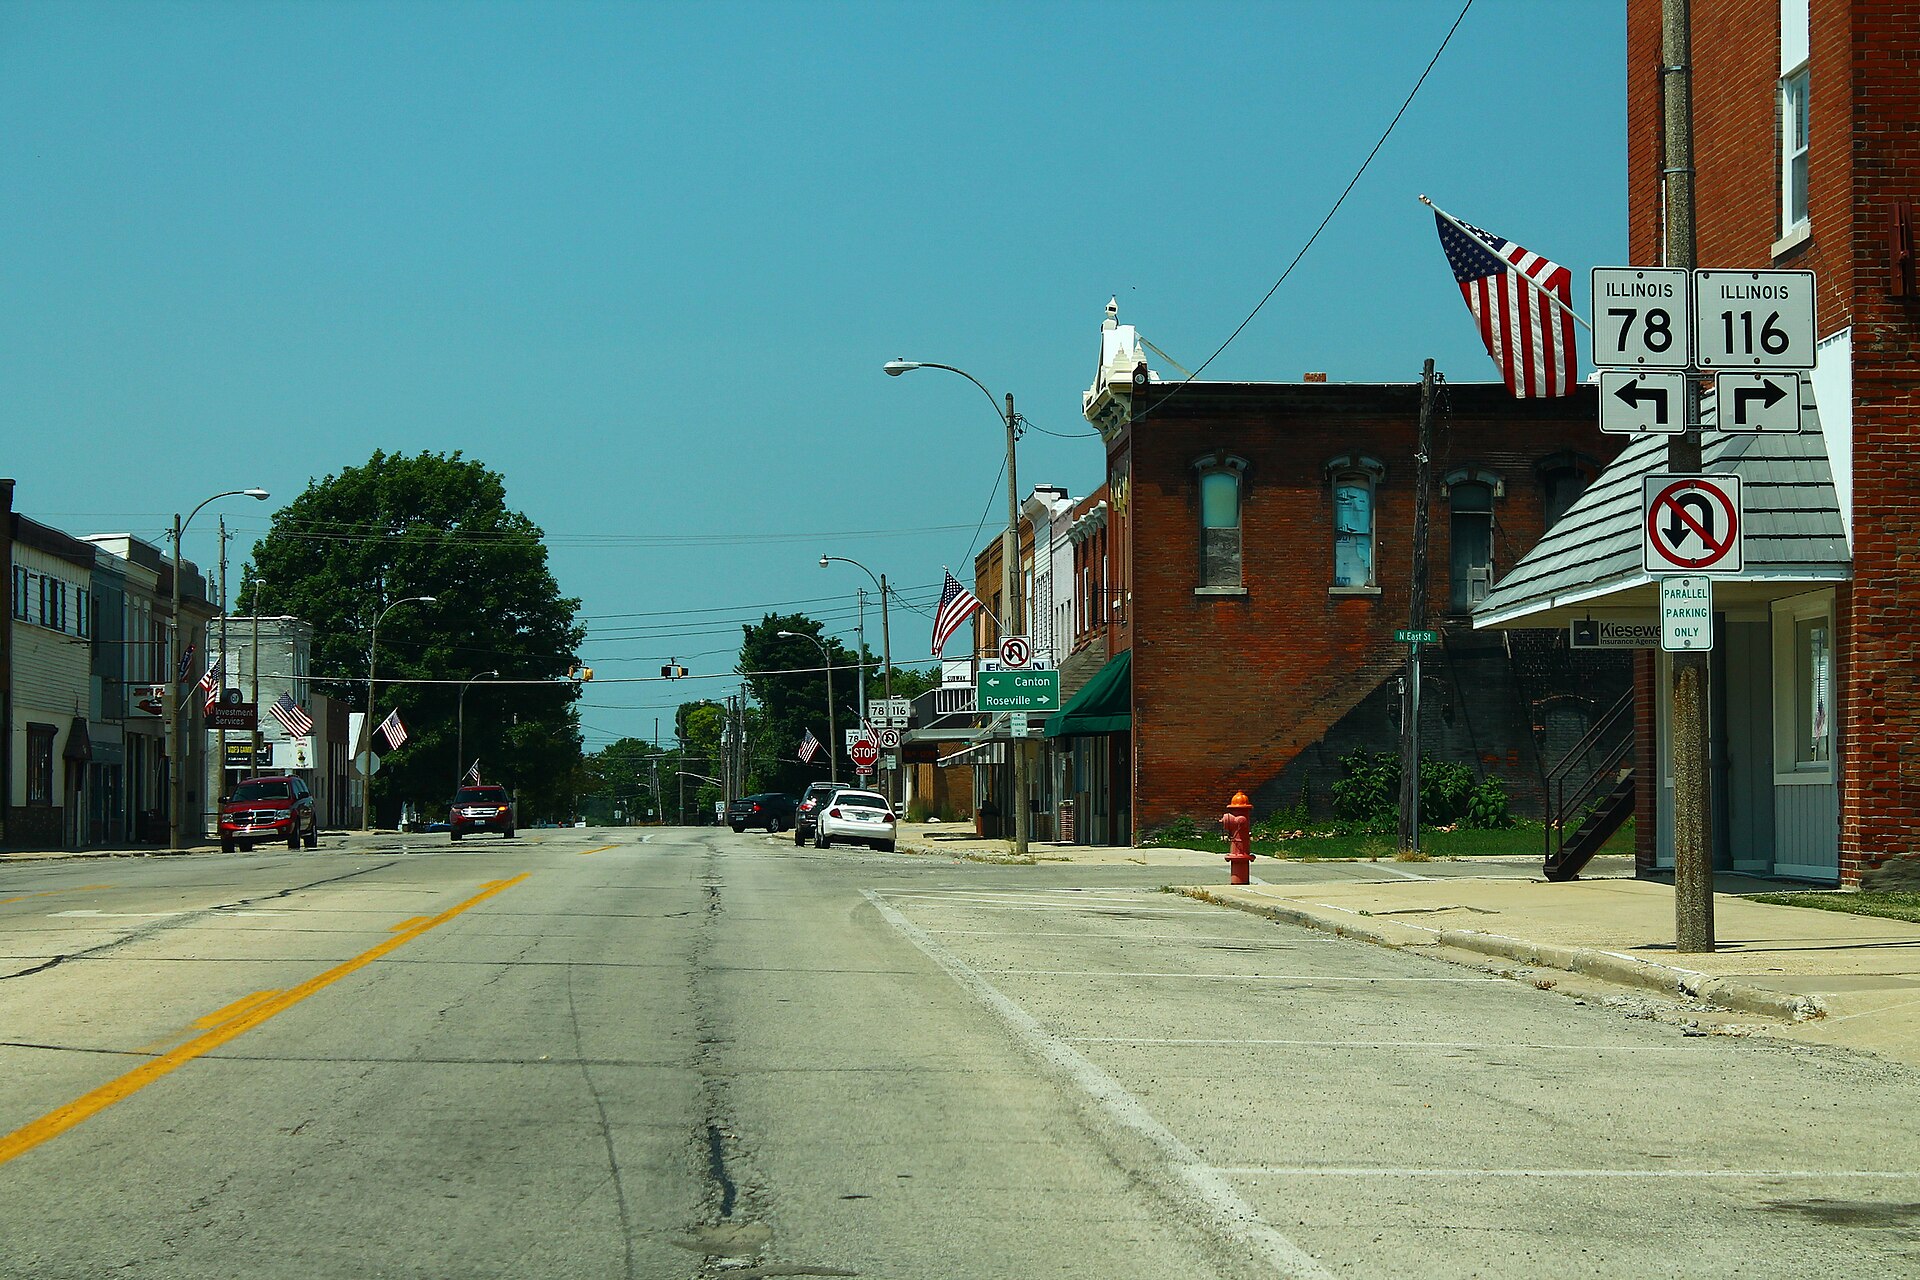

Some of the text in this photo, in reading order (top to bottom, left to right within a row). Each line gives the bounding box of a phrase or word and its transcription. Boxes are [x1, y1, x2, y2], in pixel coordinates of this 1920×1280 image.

[1606, 282, 1673, 297] ILLINOIS
[1721, 285, 1789, 300] ILLINOIS
[1607, 308, 1673, 353] 78
[1721, 310, 1790, 355] 116
[1664, 588, 1708, 599] PARALLEL
[1666, 608, 1707, 618] PARKING
[1600, 622, 1661, 637] Kiesewe
[1674, 627, 1699, 637] ONLY
[1399, 631, 1431, 641] N East St
[1635, 638, 1661, 646] Agency
[1014, 676, 1050, 687] Canton
[986, 695, 1031, 706] Roseville
[215, 707, 254, 717] Investment
[871, 706, 885, 716] 78
[892, 706, 906, 716] 116
[215, 716, 245, 725] Services
[848, 735, 859, 743] 78
[853, 747, 877, 758] STOP
